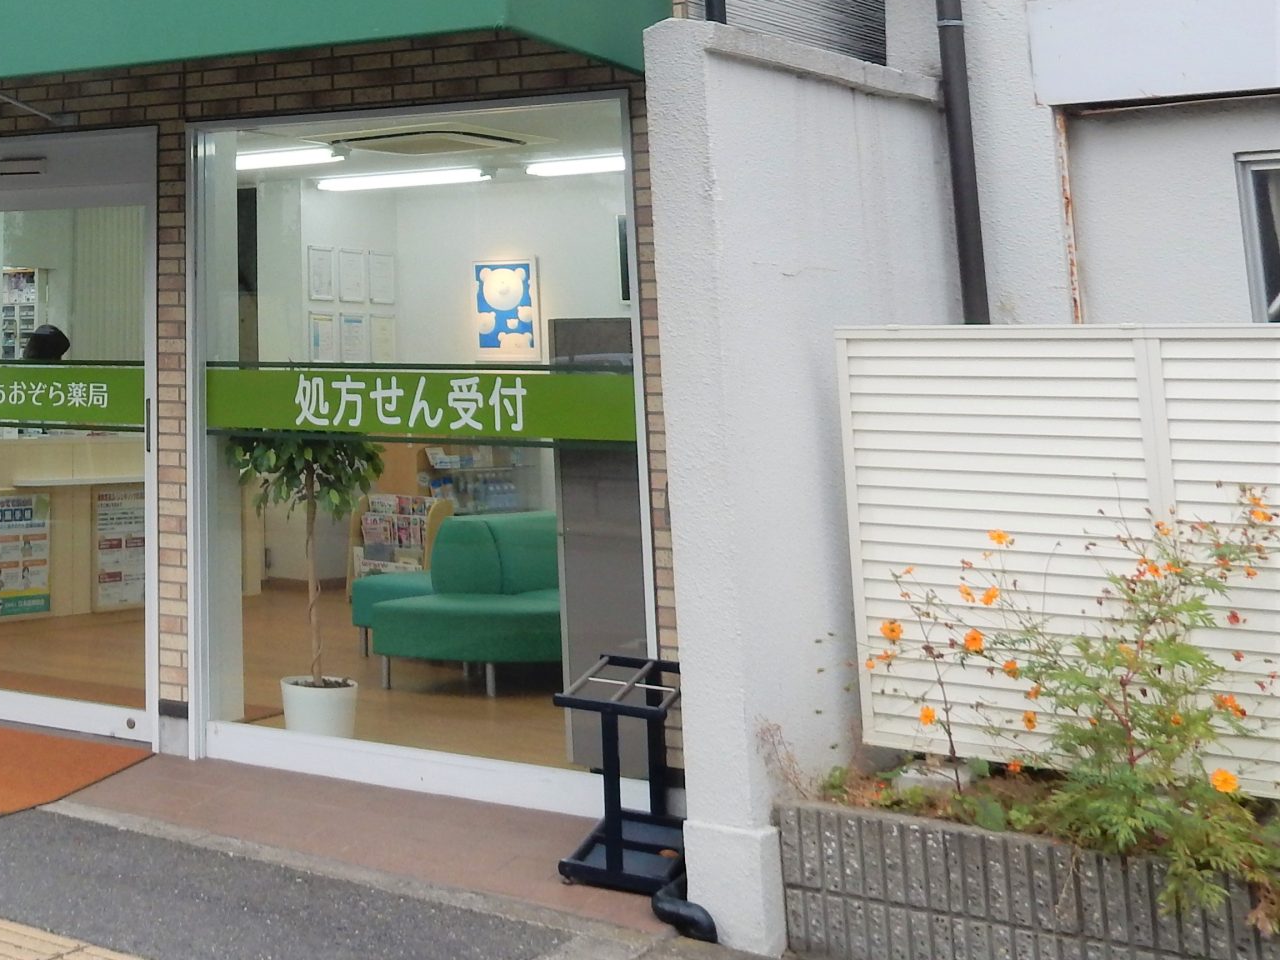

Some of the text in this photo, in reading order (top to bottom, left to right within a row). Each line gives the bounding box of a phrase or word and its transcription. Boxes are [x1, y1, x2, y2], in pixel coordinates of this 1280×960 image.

[294, 373, 527, 432] 処方せん受付
